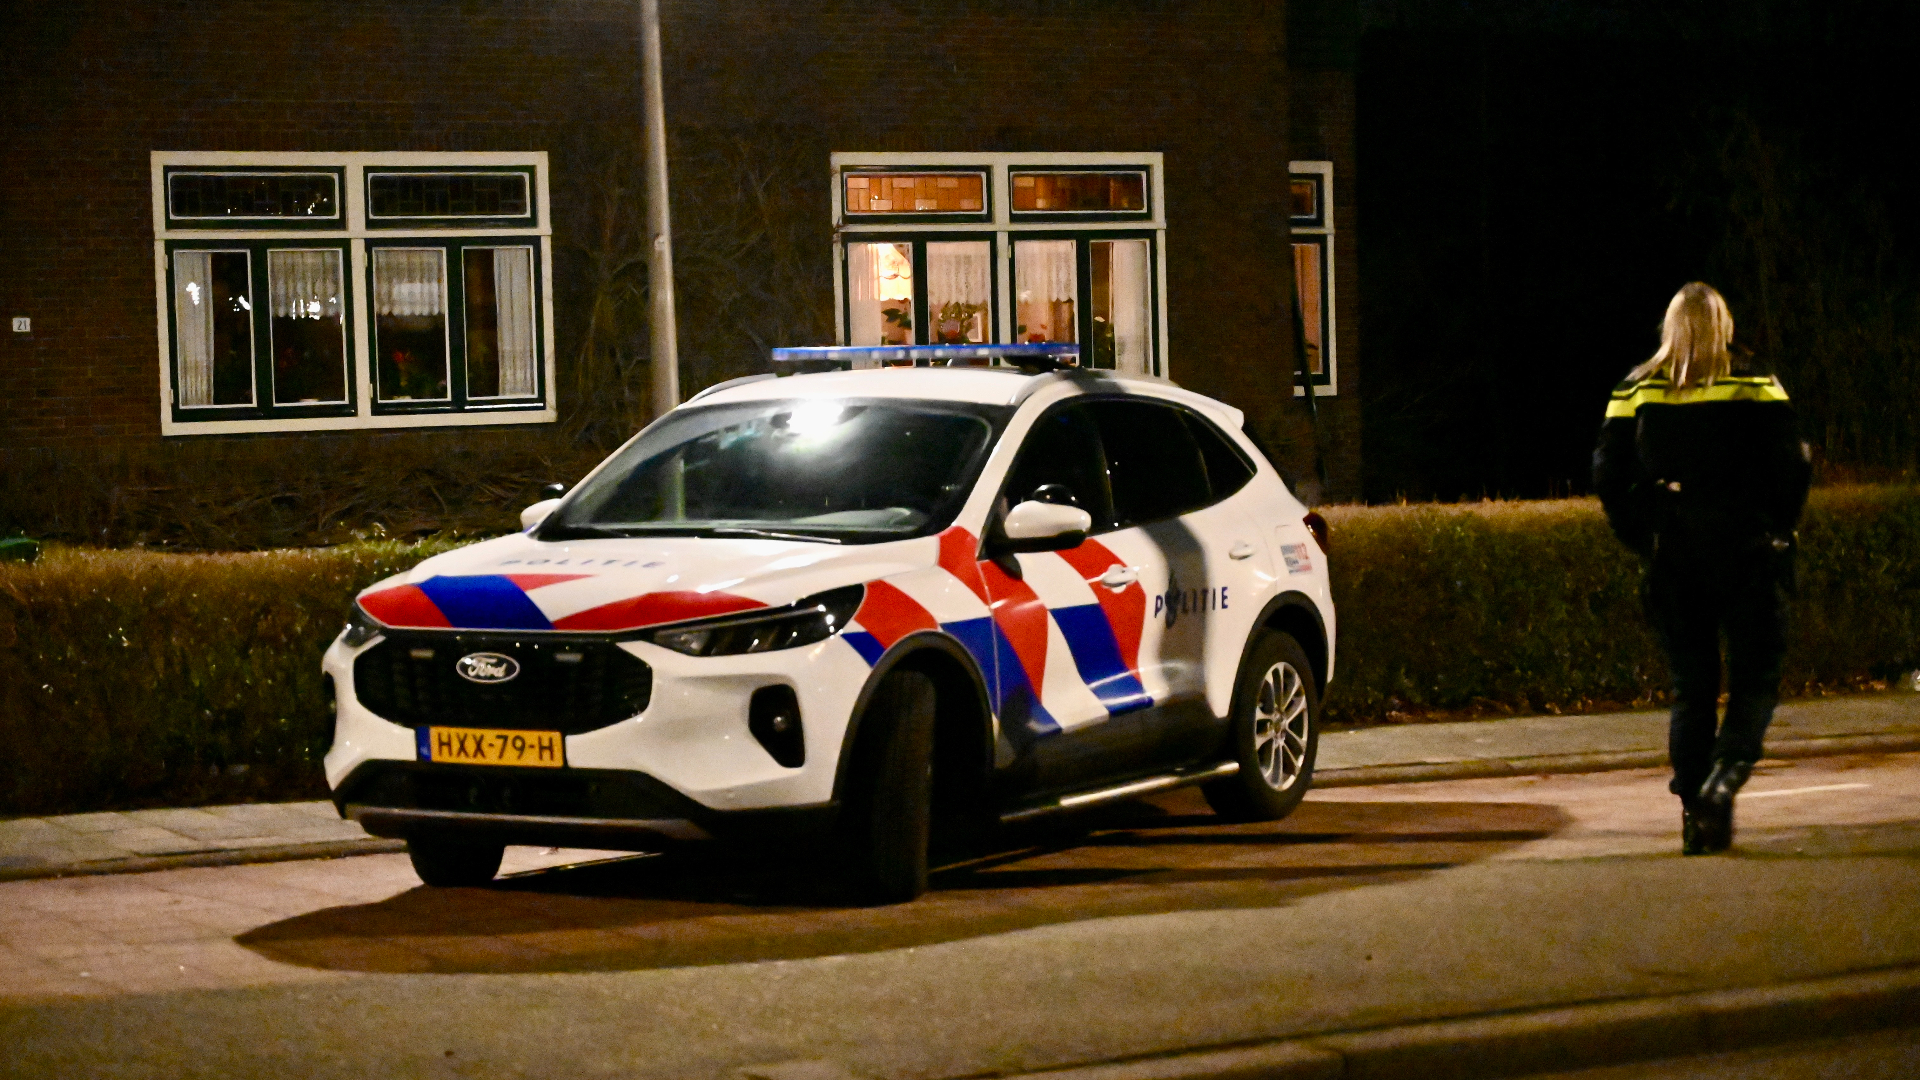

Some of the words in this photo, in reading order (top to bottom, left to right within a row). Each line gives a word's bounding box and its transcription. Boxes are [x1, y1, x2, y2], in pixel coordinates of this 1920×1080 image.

[17, 320, 27, 331] 21
[467, 656, 508, 677] Ford
[437, 732, 555, 761] HXX-79-H
